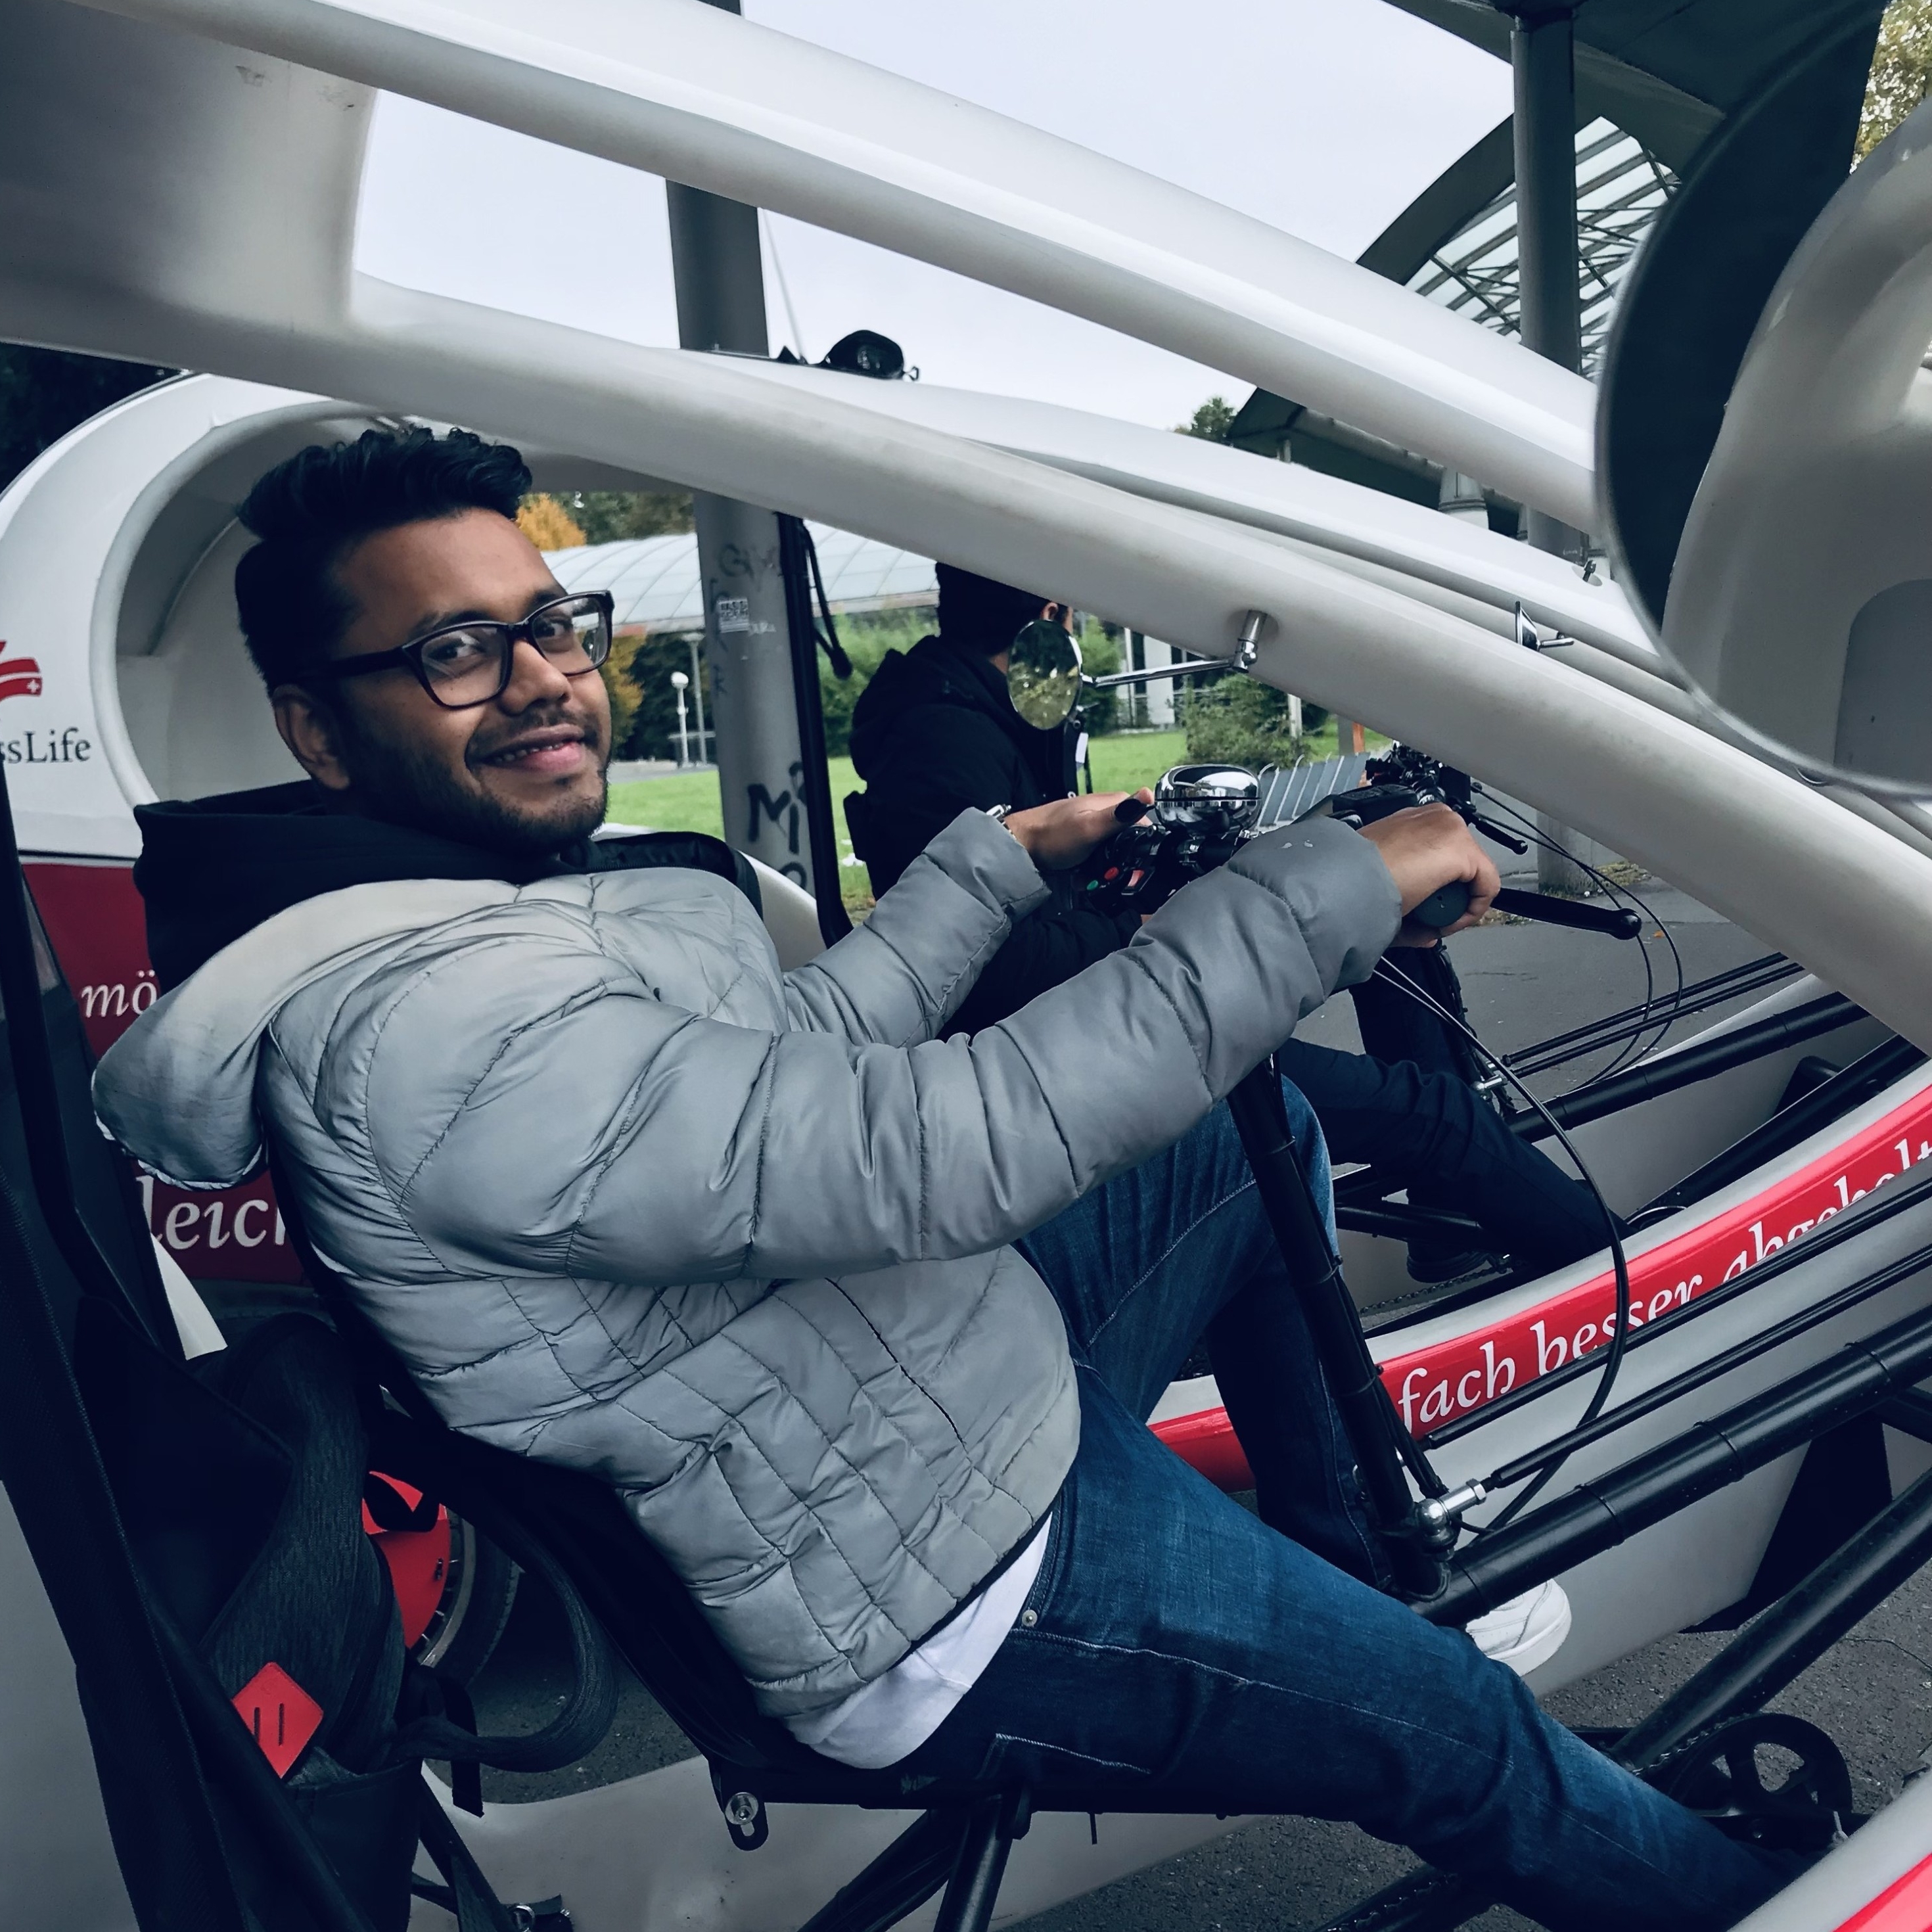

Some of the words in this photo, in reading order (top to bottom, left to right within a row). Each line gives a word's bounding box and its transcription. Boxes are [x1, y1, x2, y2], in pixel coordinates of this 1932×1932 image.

[0, 726, 91, 763] sLife
[81, 969, 157, 1018] mö
[135, 1175, 286, 1249] leic
[1398, 1340, 1516, 1434] fach
[1530, 1274, 1703, 1376] besser
